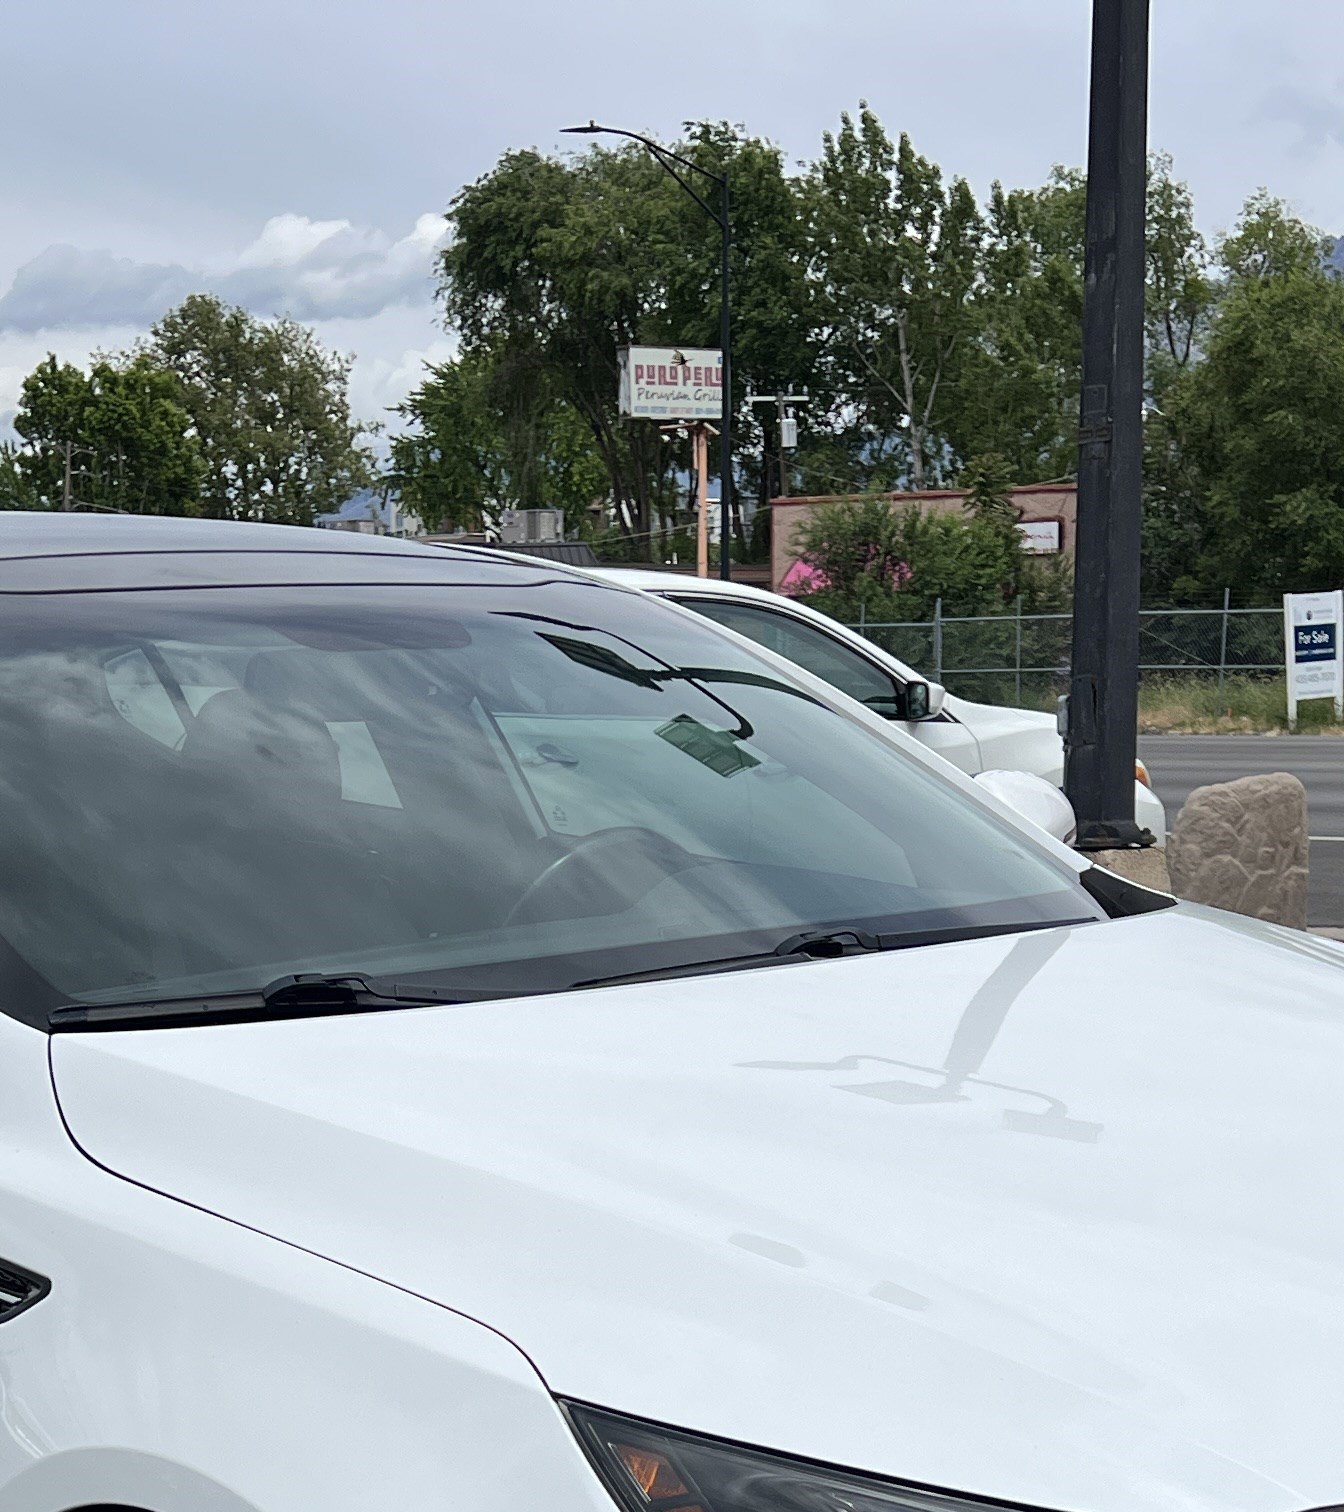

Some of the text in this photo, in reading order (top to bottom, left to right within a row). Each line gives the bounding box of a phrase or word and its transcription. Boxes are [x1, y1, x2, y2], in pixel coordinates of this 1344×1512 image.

[634, 364, 678, 386] PURO
[637, 387, 691, 401] Peruvian
[1298, 630, 1329, 645] For Sale
